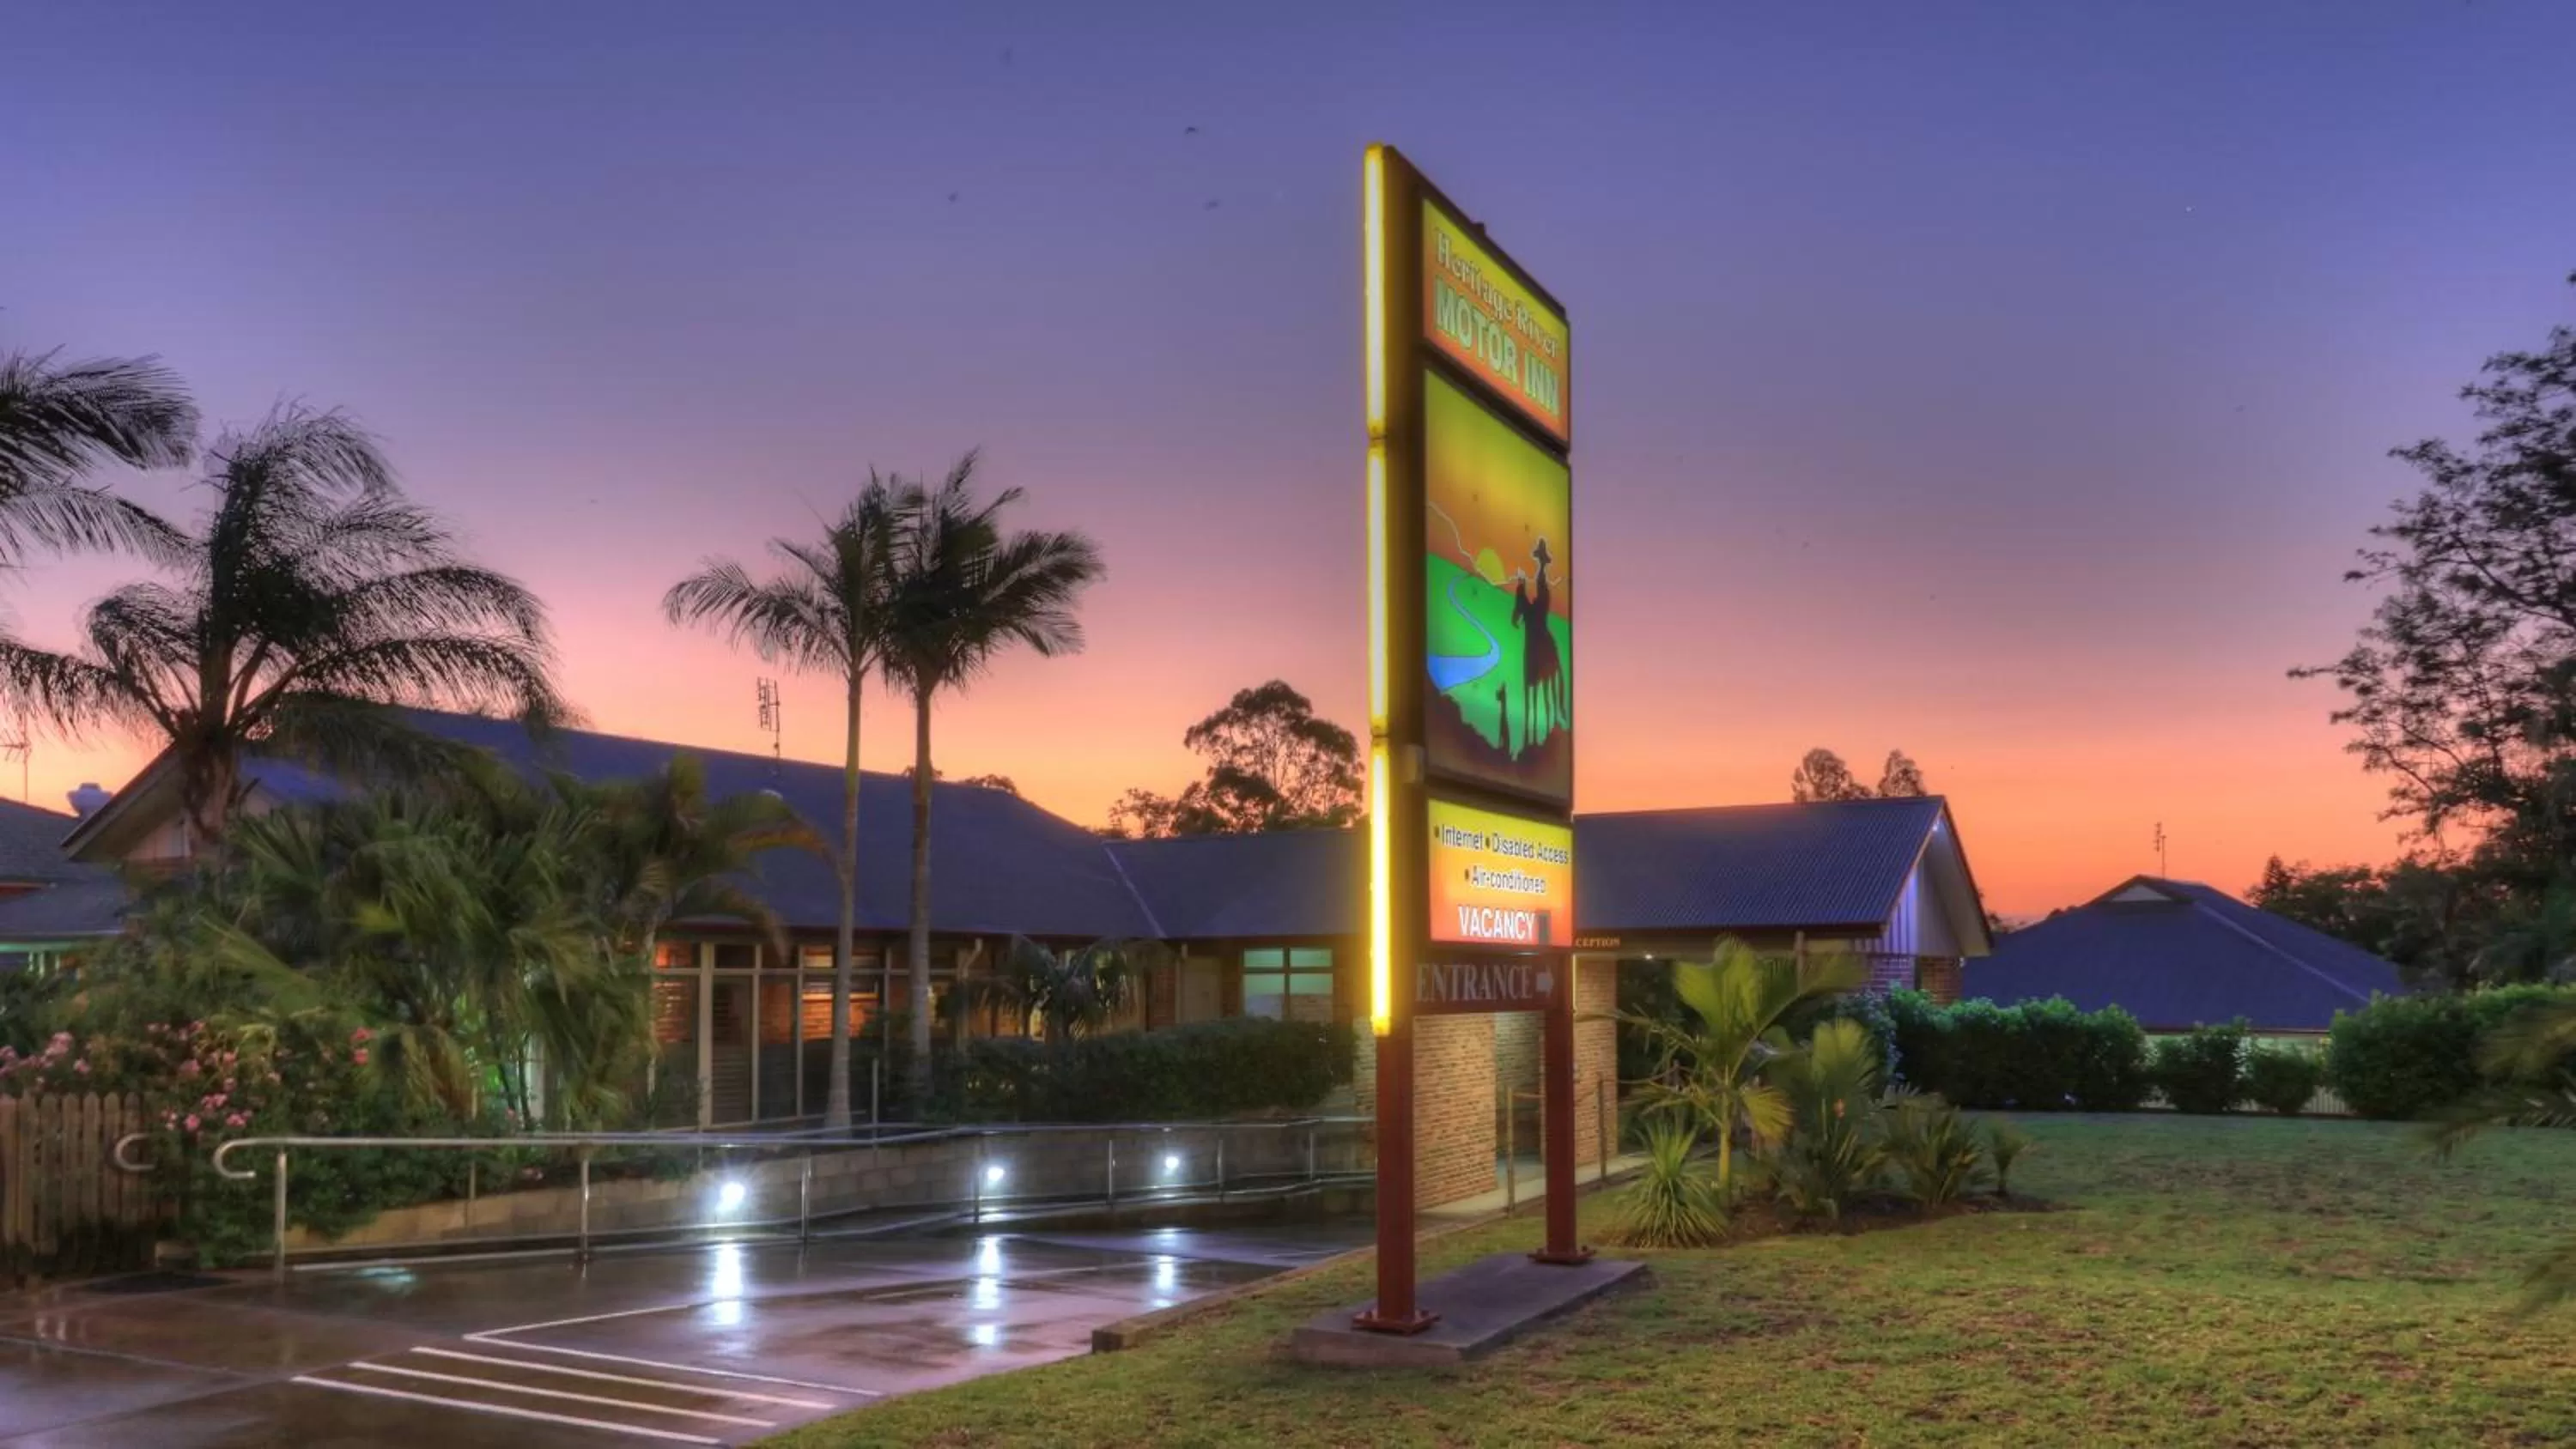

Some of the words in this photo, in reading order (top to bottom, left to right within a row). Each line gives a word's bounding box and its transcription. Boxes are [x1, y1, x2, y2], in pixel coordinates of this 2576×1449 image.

[1437, 231, 1513, 321] Heritage
[1516, 300, 1558, 359] River
[1435, 275, 1518, 385] MOTOR
[1524, 350, 1559, 415] INN
[1442, 824, 1484, 851] Internet
[1492, 833, 1534, 859] Disabled
[1536, 845, 1569, 865] Access
[1471, 865, 1546, 894] Air-conditioned
[1457, 906, 1535, 941] VACANCY
[1576, 937, 1621, 949] CEPTION
[1416, 963, 1533, 1003] ENTRANCE
